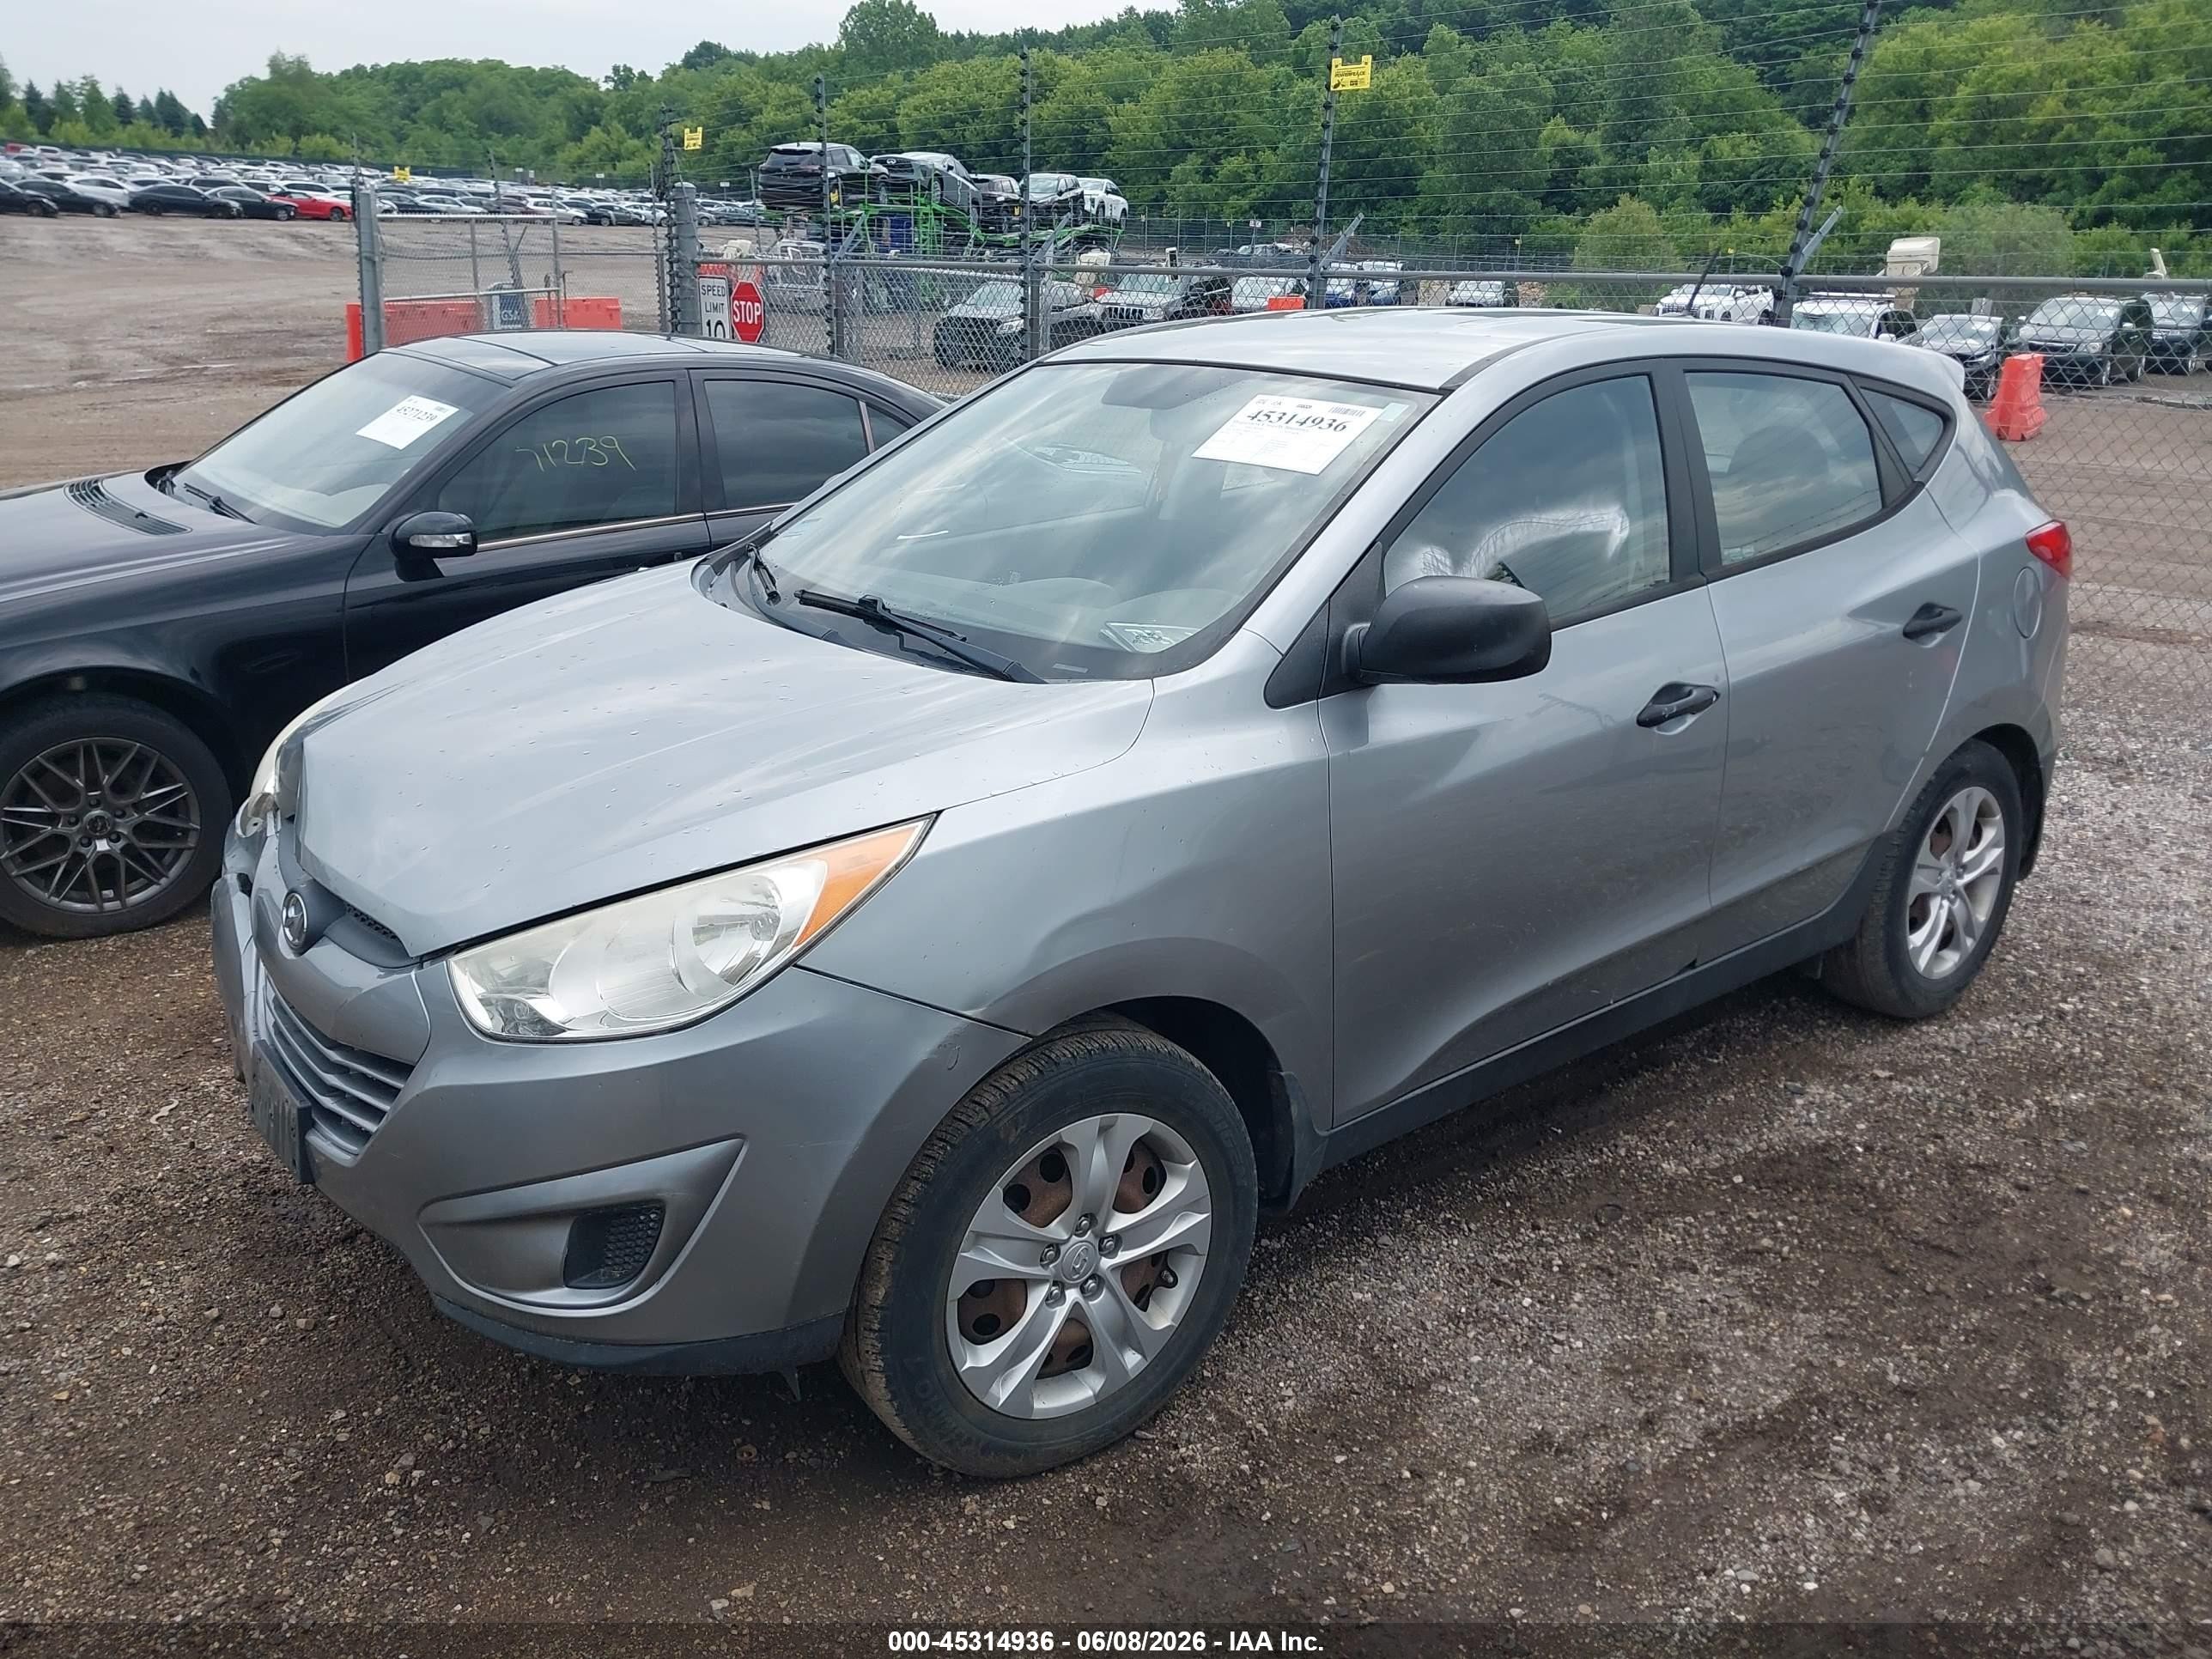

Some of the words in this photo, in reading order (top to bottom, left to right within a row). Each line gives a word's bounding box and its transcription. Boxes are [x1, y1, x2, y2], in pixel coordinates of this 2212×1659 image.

[701, 284, 726, 297] SPEED
[705, 301, 725, 314] LIMIT
[732, 300, 762, 325] STOP
[1247, 409, 1354, 433] 45314936
[515, 435, 637, 472] 71239
